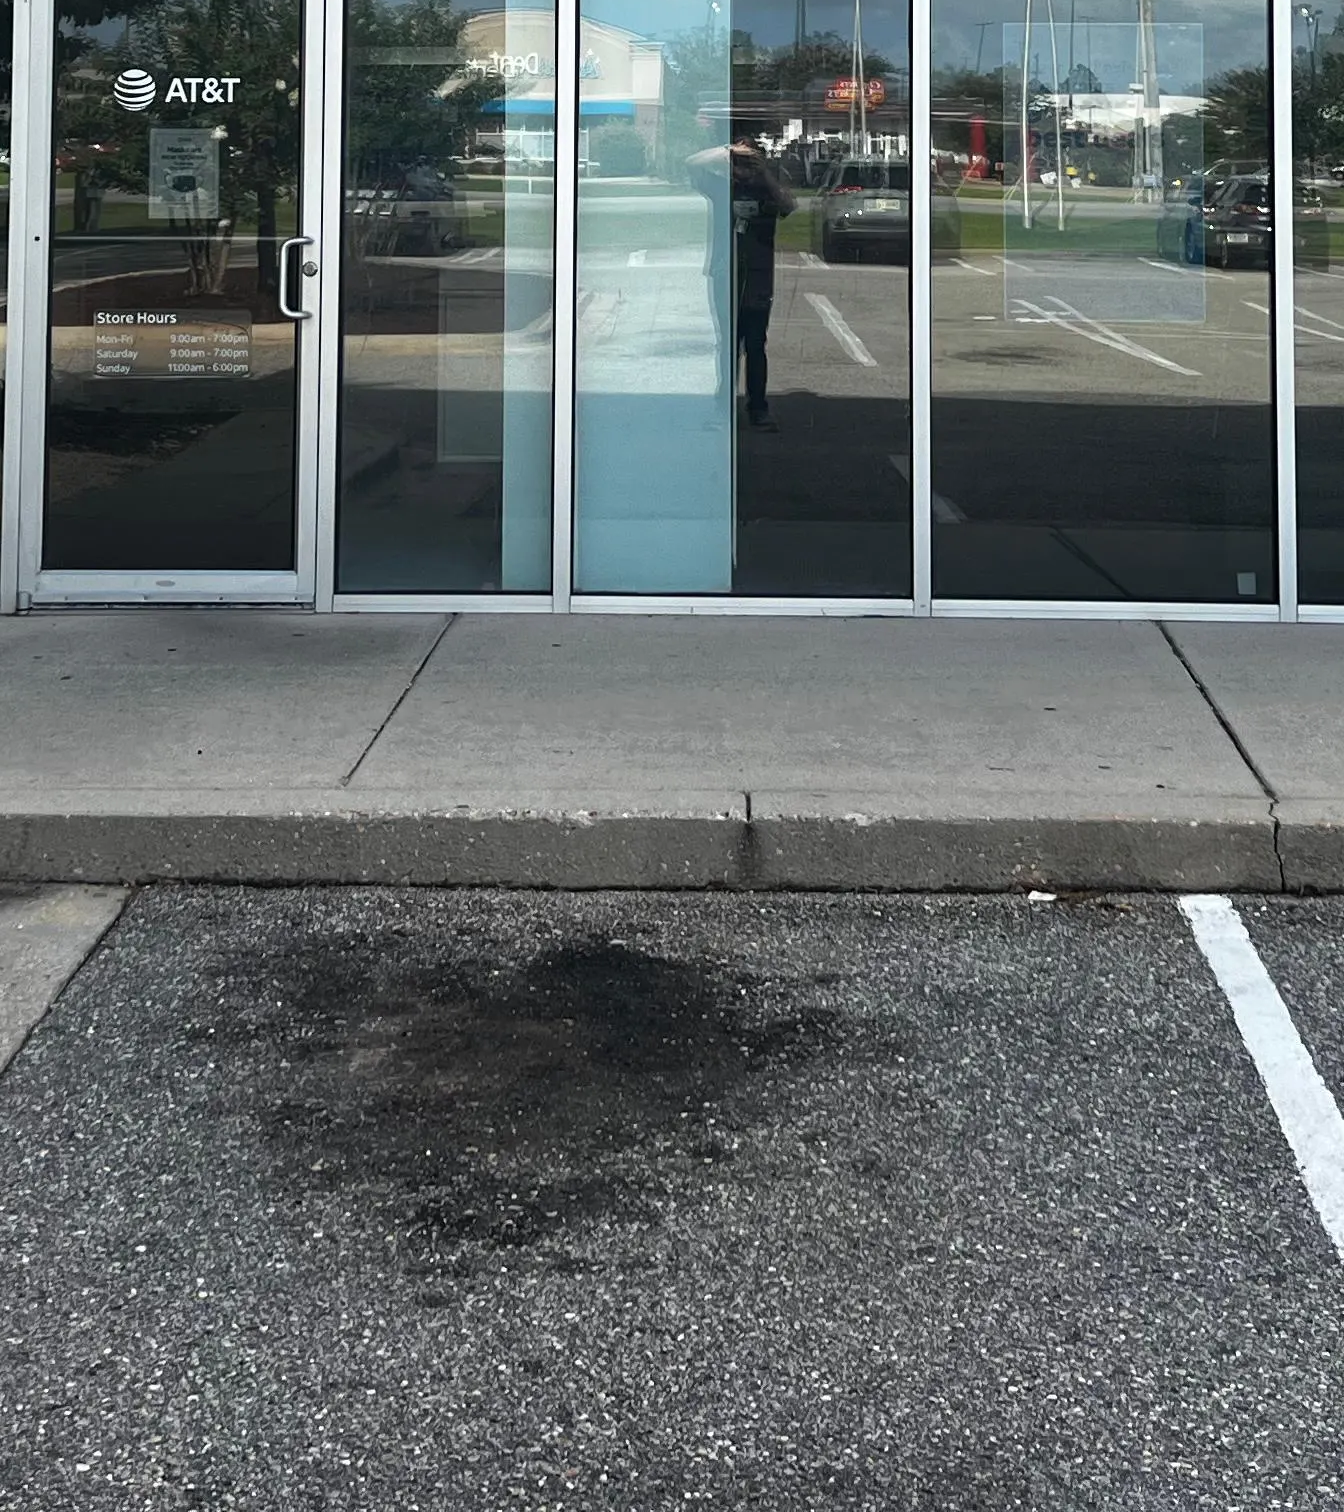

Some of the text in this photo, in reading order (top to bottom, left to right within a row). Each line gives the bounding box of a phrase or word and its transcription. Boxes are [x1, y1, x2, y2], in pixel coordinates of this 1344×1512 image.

[165, 76, 241, 103] AT&T
[97, 312, 177, 324] Store Hours
[96, 349, 139, 360] Saturday
[213, 348, 249, 359] 7:00pm
[96, 364, 131, 375] Sunday
[212, 363, 249, 374] 6:00pm
